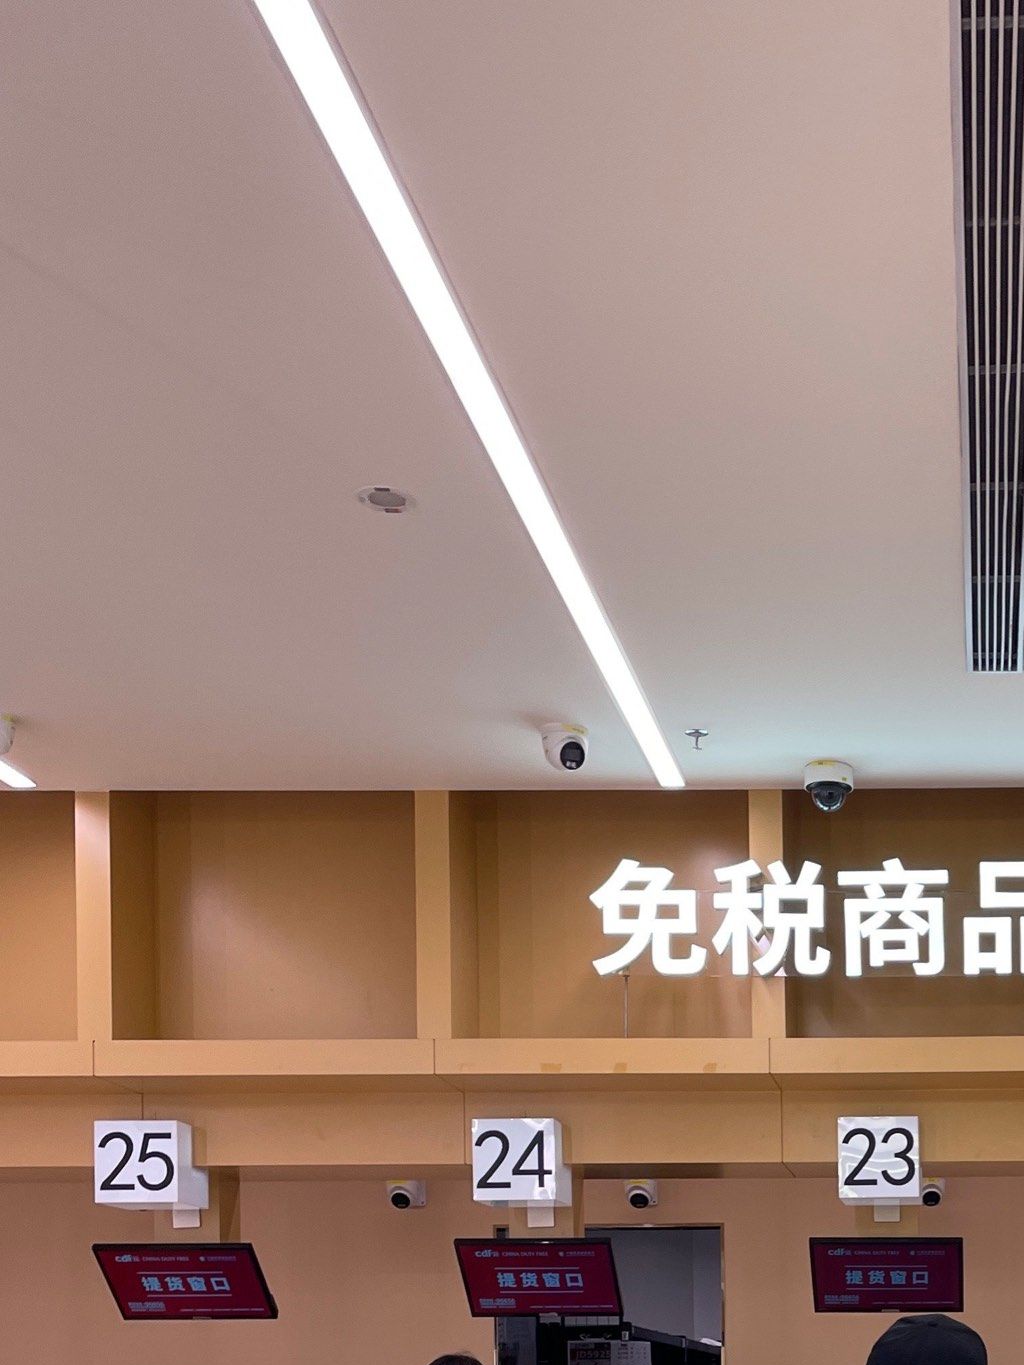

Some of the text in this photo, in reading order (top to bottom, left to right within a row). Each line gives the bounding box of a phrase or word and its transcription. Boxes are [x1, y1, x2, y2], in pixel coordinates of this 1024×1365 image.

[97, 1133, 175, 1191] 25
[475, 1130, 553, 1188] 24
[841, 1127, 916, 1186] 23
[141, 1276, 230, 1292] 提货窗口
[497, 1272, 583, 1288] 提货窗口
[845, 1270, 929, 1285] 提货窗口
